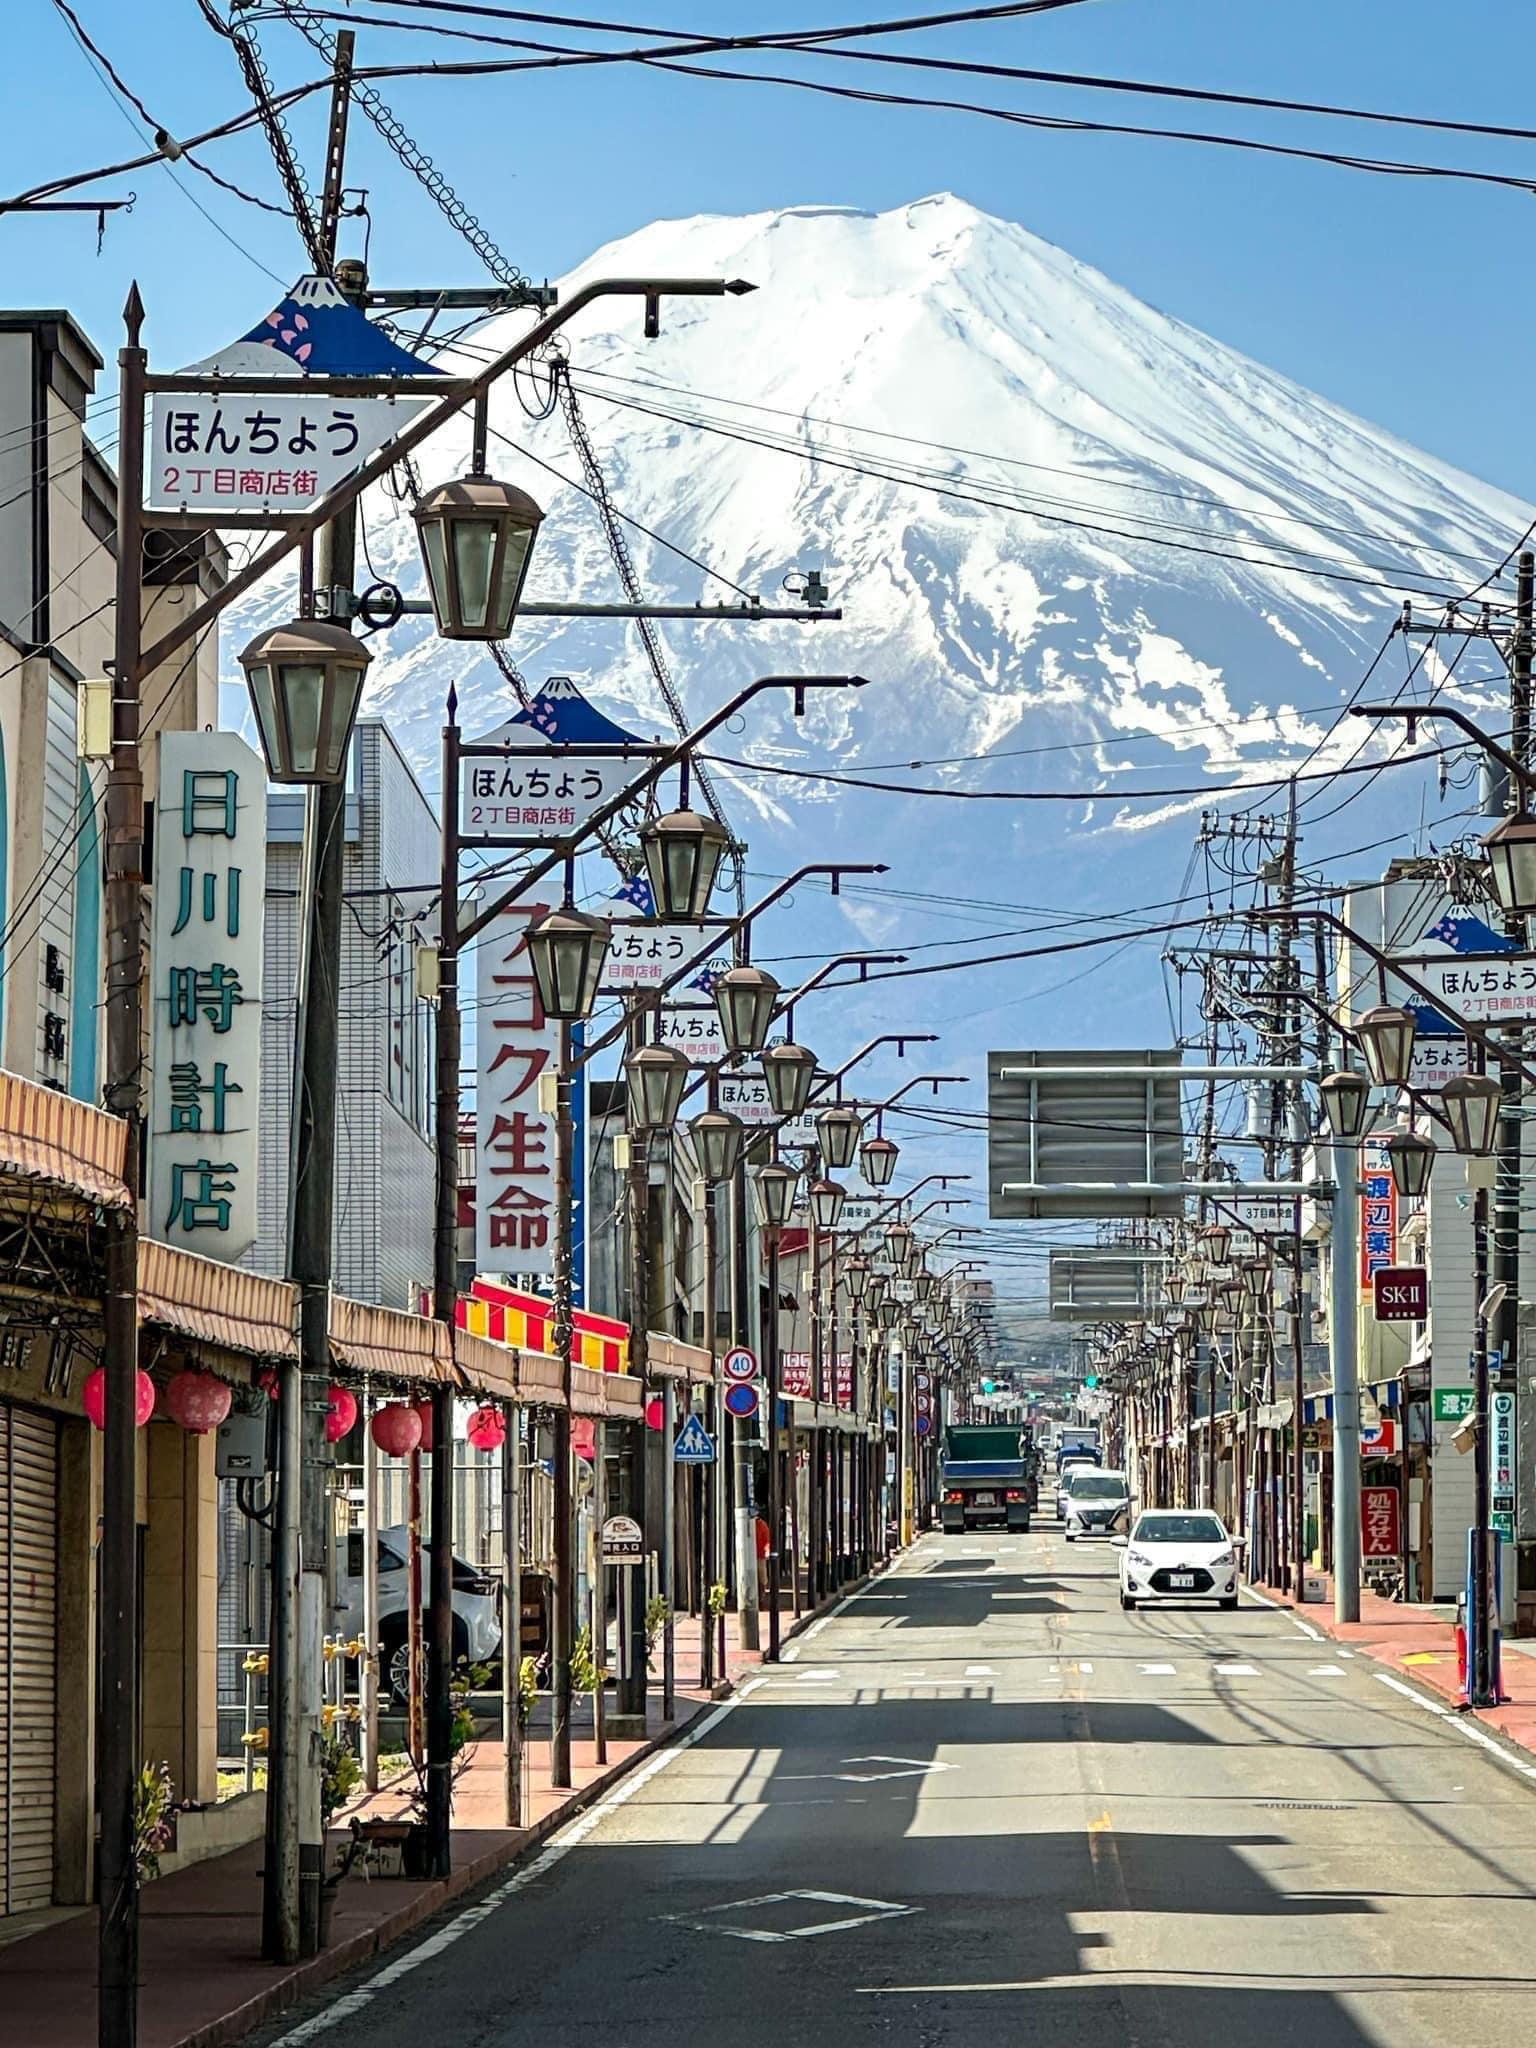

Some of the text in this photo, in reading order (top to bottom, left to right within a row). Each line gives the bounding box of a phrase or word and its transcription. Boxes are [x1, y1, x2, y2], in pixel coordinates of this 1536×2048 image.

[164, 409, 361, 457] ほんちょう
[162, 468, 319, 498] 2丁目商店街
[472, 767, 604, 800] ほんちょう
[471, 806, 577, 826] 2丁目商店街
[609, 935, 684, 961] んちょう
[602, 964, 663, 979] 目商店街
[1442, 966, 1536, 995] ほんちょう
[165, 768, 243, 1233] 日川時計店
[659, 1018, 719, 1038] ほんちょ
[1411, 1047, 1467, 1066] んちょう
[722, 1086, 770, 1103] ほんち
[1381, 1286, 1421, 1304] SK-II
[732, 1356, 750, 1372] 40
[1367, 1493, 1392, 1553] 処方せん
